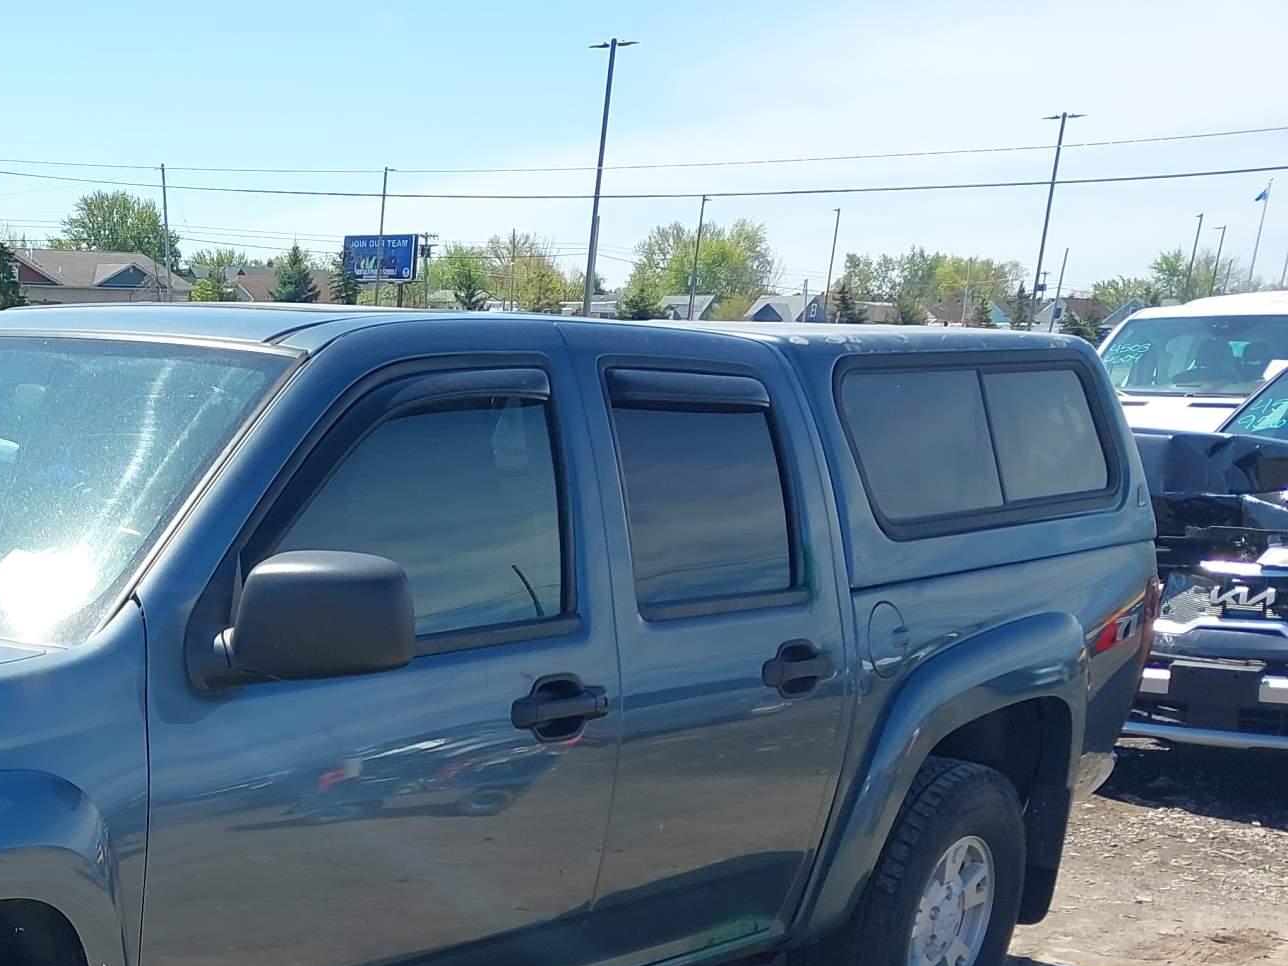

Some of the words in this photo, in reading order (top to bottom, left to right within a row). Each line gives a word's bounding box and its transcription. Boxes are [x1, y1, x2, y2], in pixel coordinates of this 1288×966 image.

[350, 239, 368, 248] JOIN
[387, 239, 409, 247] TEAM
[1209, 585, 1276, 606] KIA
